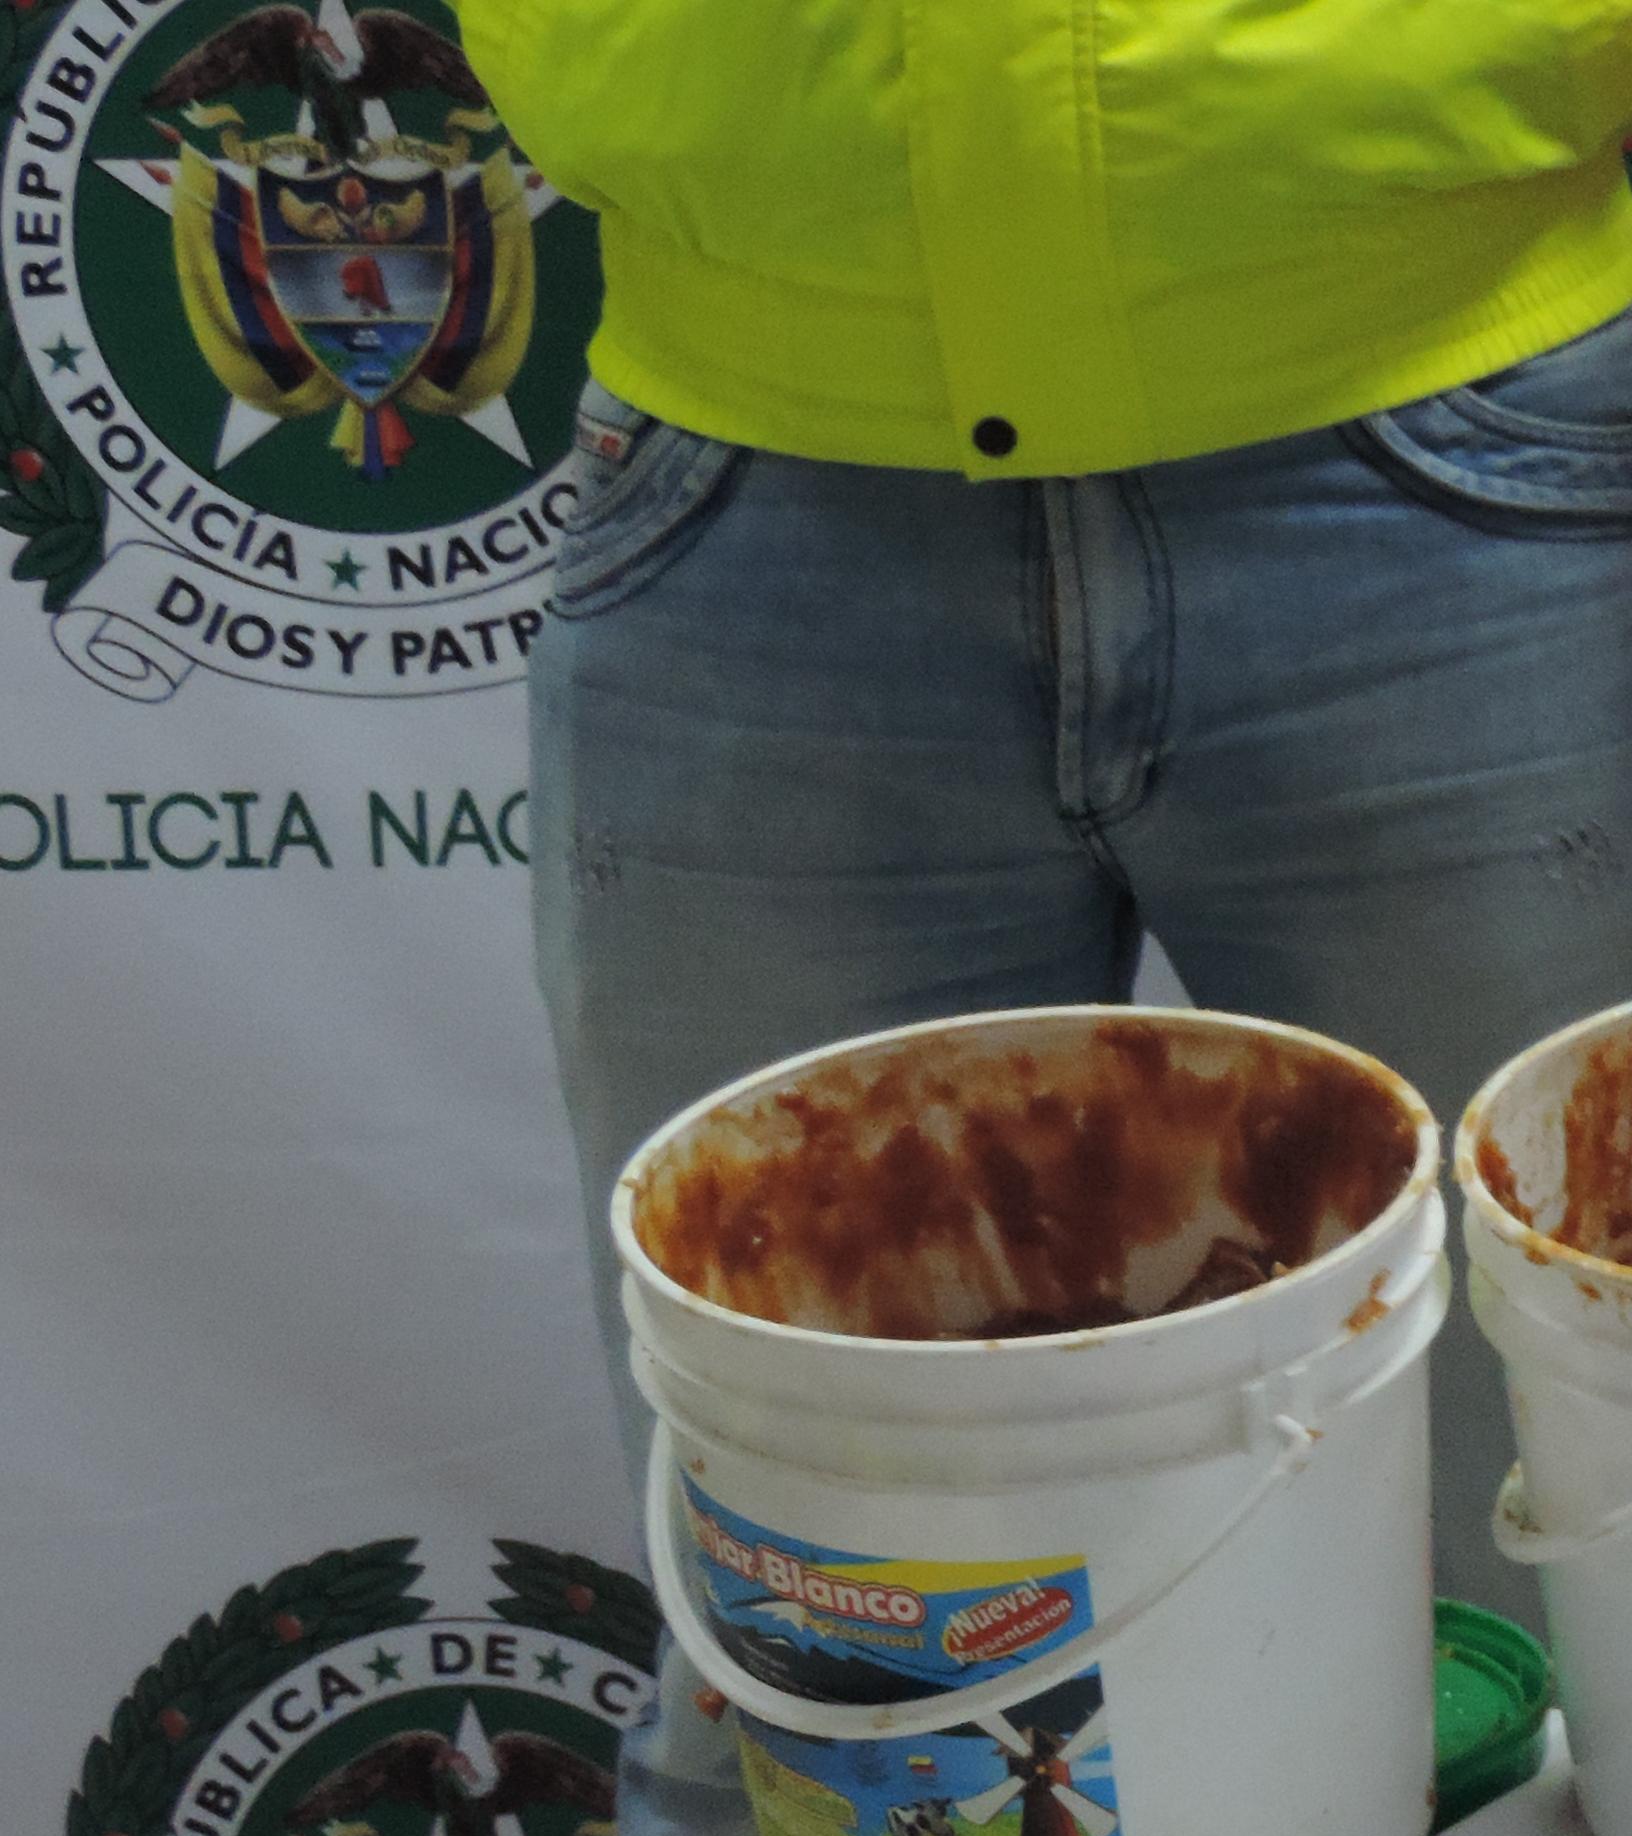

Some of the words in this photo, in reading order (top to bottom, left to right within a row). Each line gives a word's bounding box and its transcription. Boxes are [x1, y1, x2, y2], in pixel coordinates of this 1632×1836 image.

[17, 0, 158, 297] REPÚBLI
[758, 1546, 923, 1625] Blanco
[430, 1632, 518, 1677] DE
